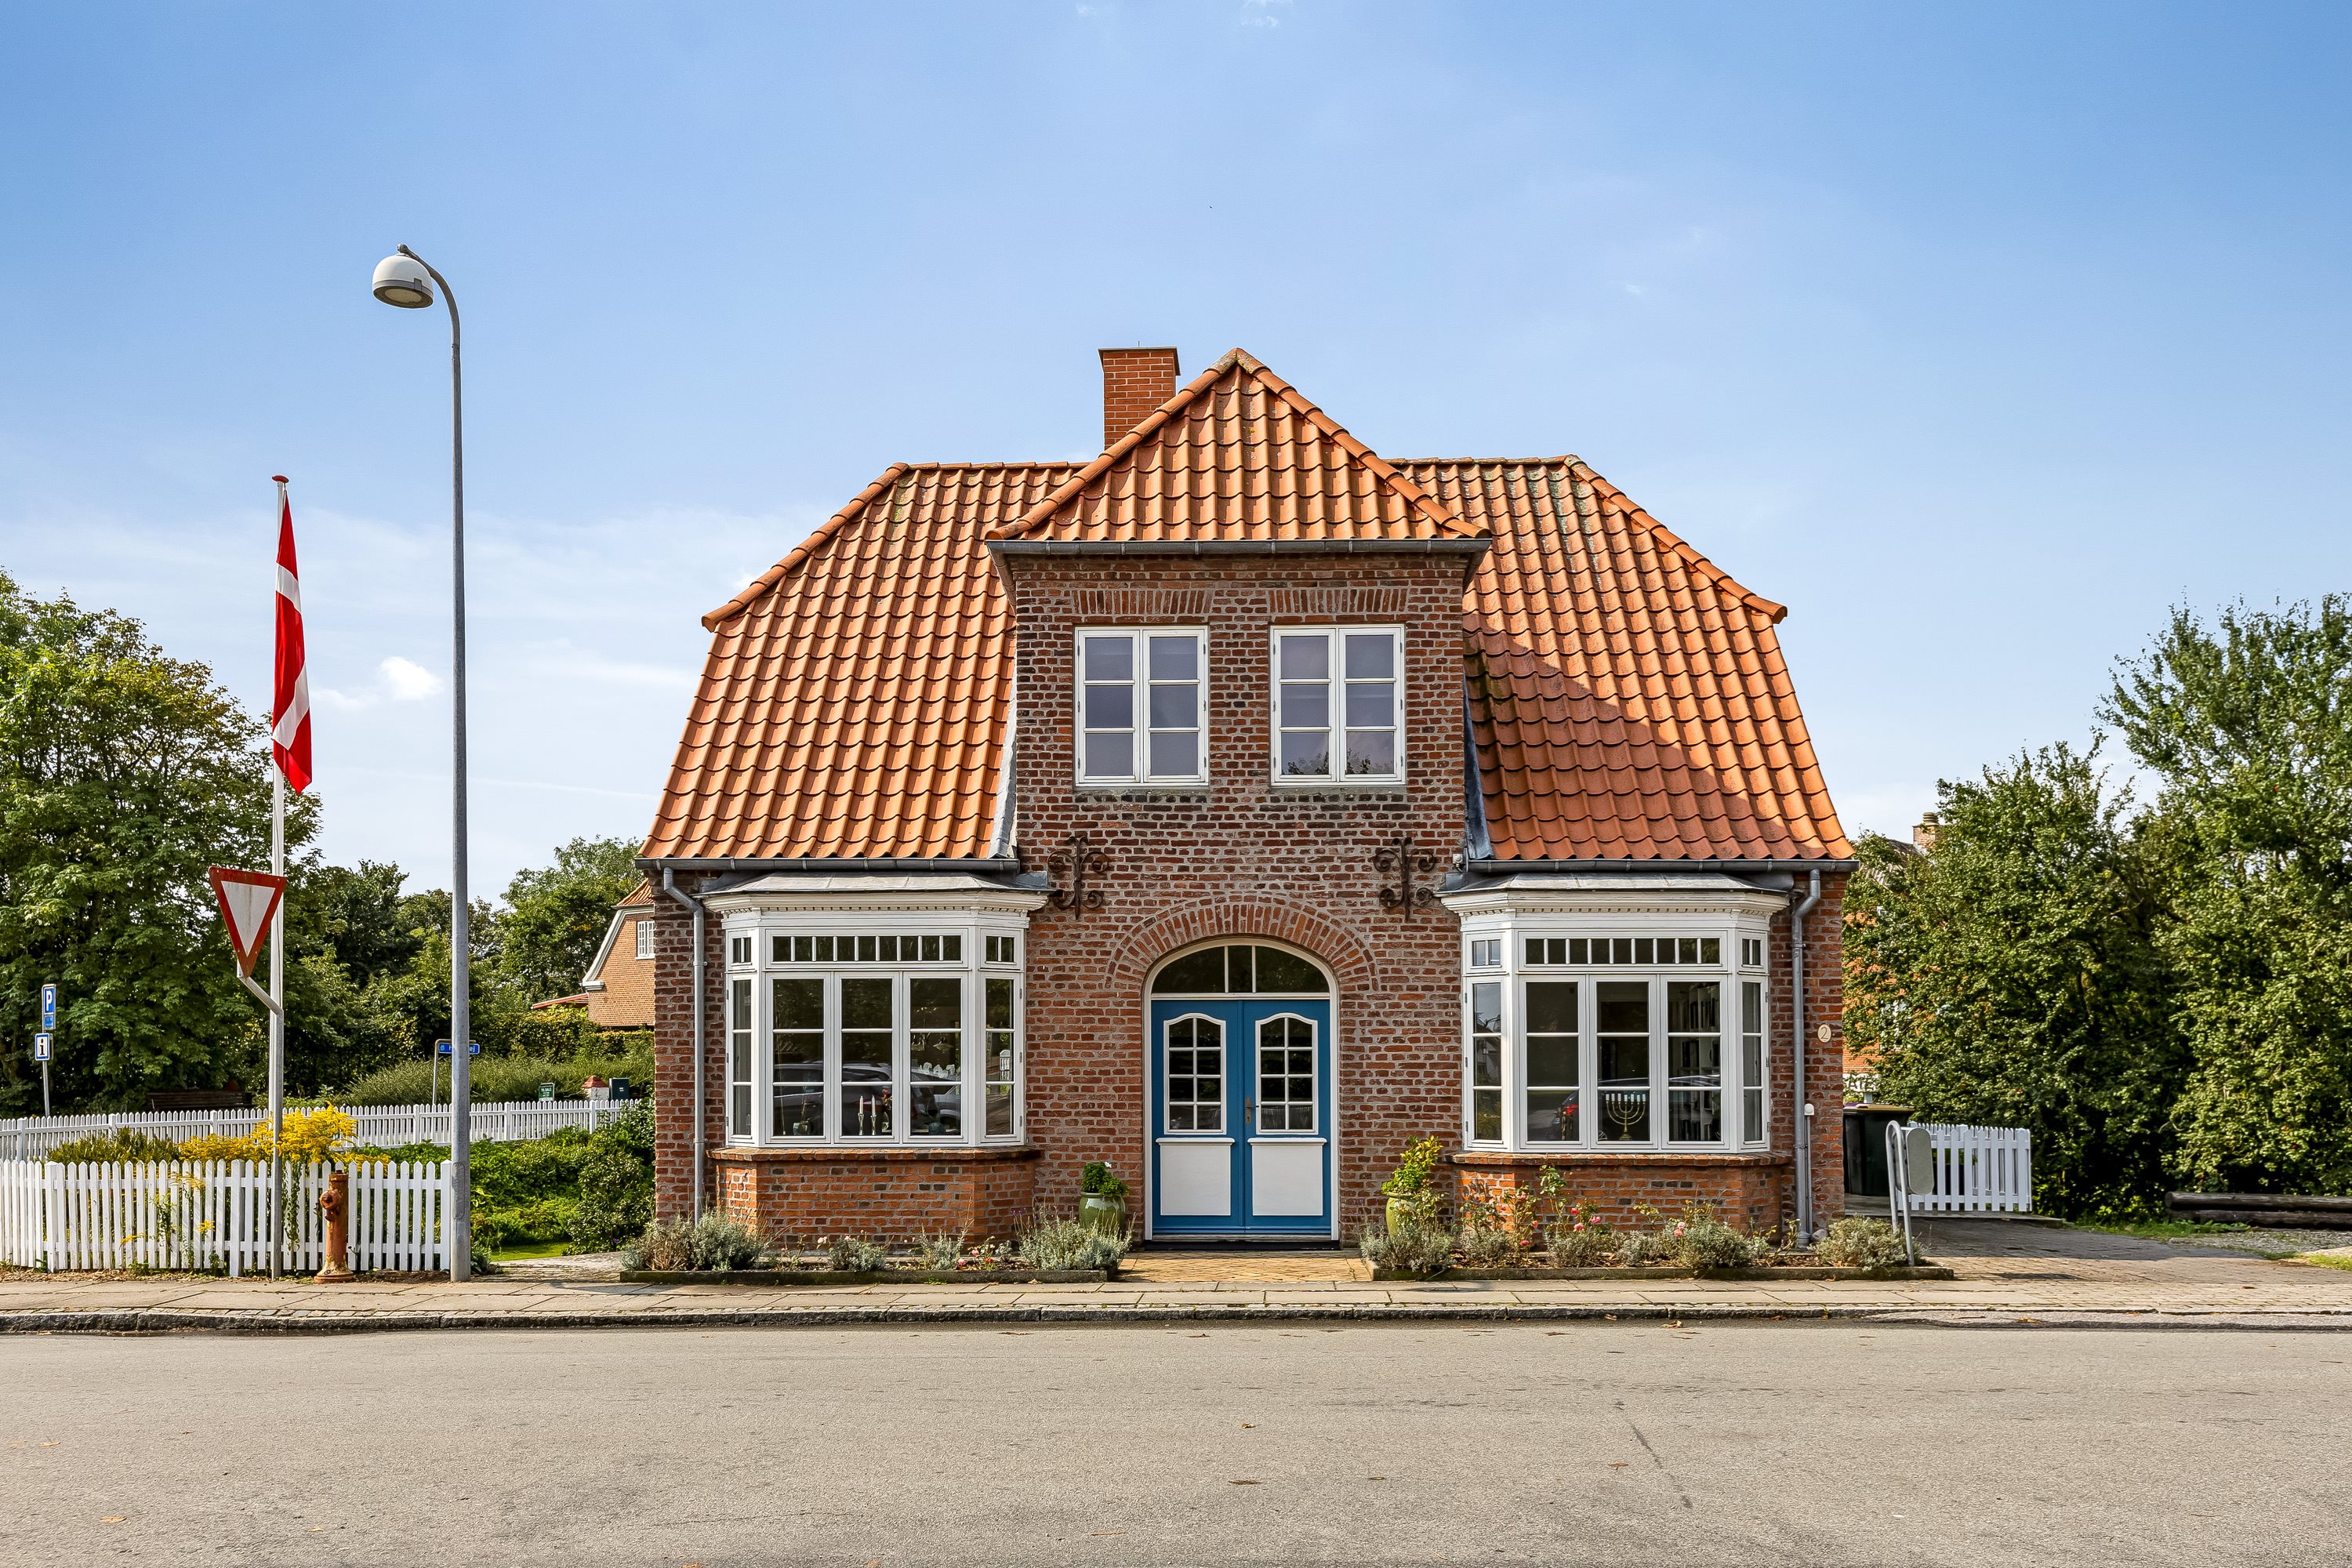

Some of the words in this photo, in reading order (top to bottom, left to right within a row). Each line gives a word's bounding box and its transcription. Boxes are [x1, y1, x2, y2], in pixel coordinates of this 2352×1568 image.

[46, 990, 53, 1011] P
[1820, 1027, 1829, 1039] 2
[39, 1038, 45, 1055] i
